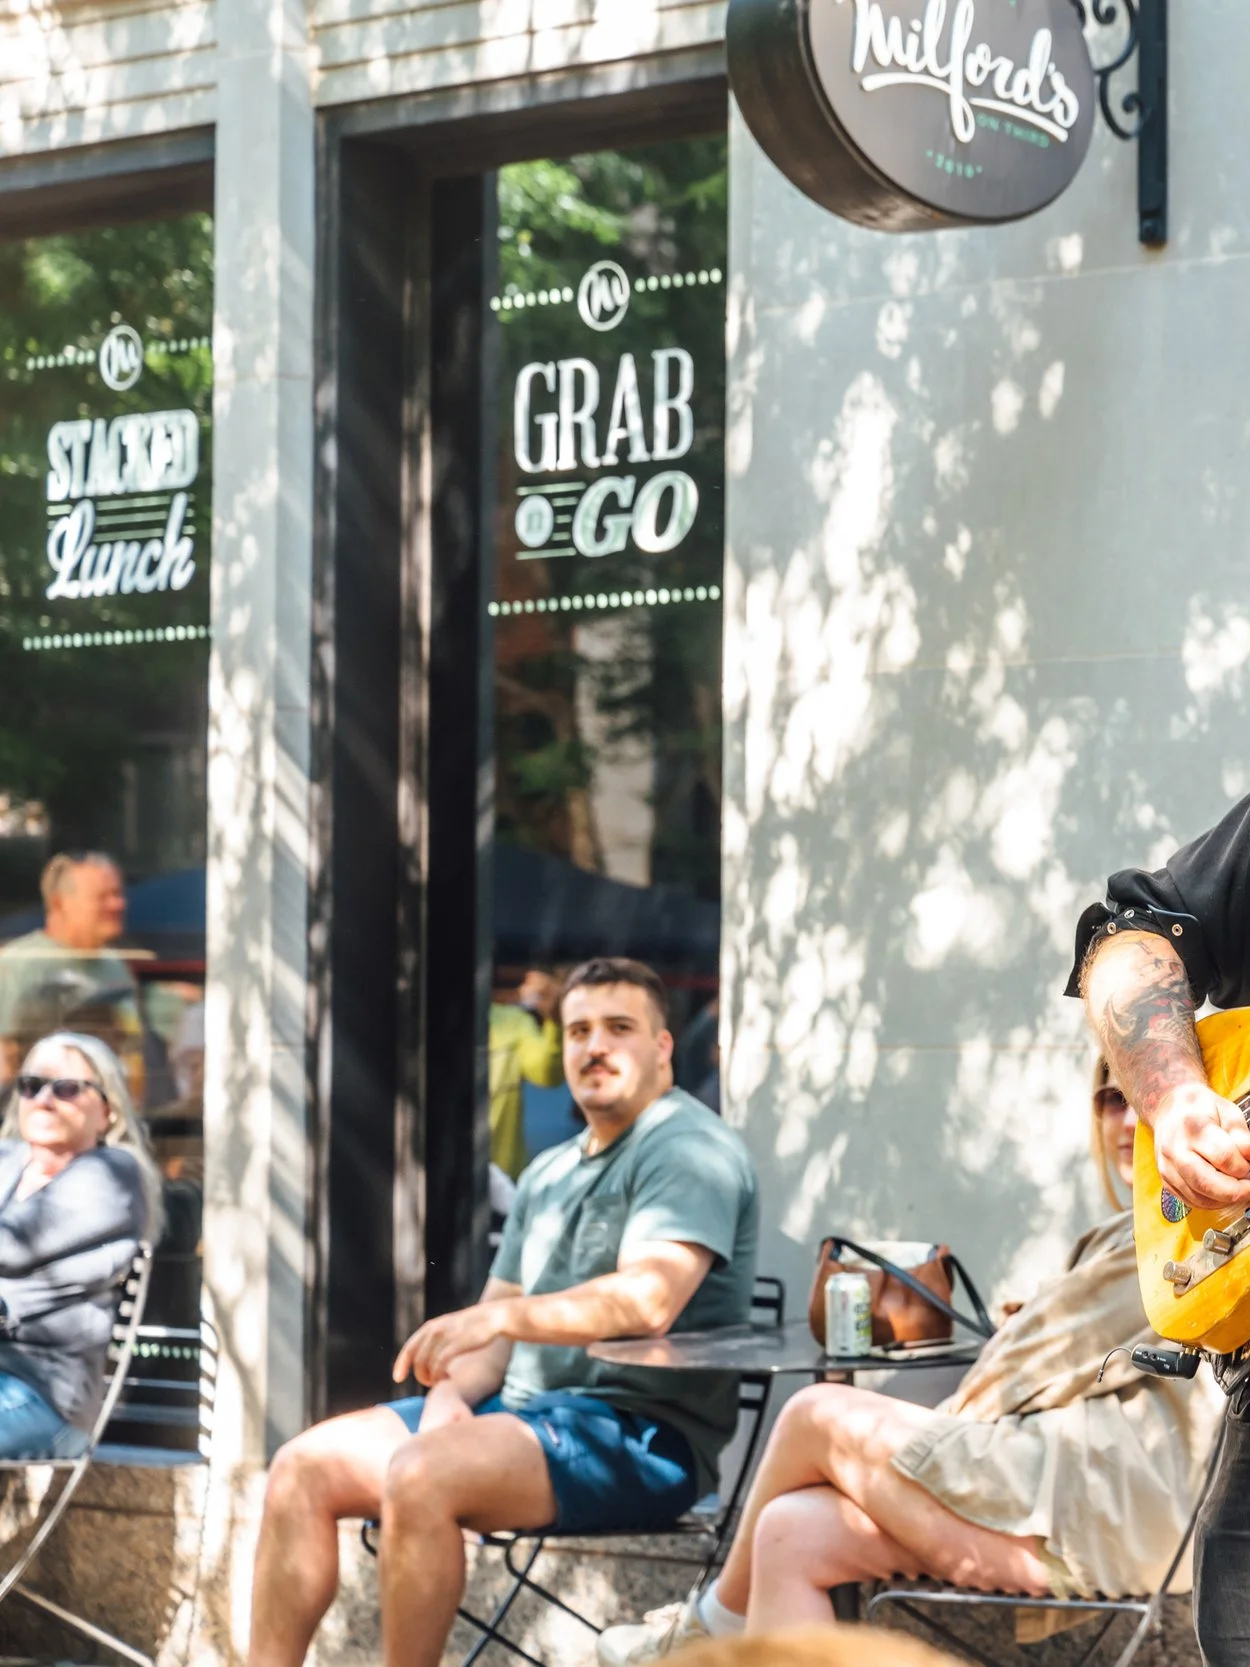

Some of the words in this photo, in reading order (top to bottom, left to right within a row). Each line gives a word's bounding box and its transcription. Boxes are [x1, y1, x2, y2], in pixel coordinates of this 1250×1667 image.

[838, 0, 1079, 142] Milford's
[46, 408, 199, 501] STACKED
[514, 347, 695, 474] GRAB
[46, 491, 196, 600] Lunch
[572, 470, 698, 558] GO
